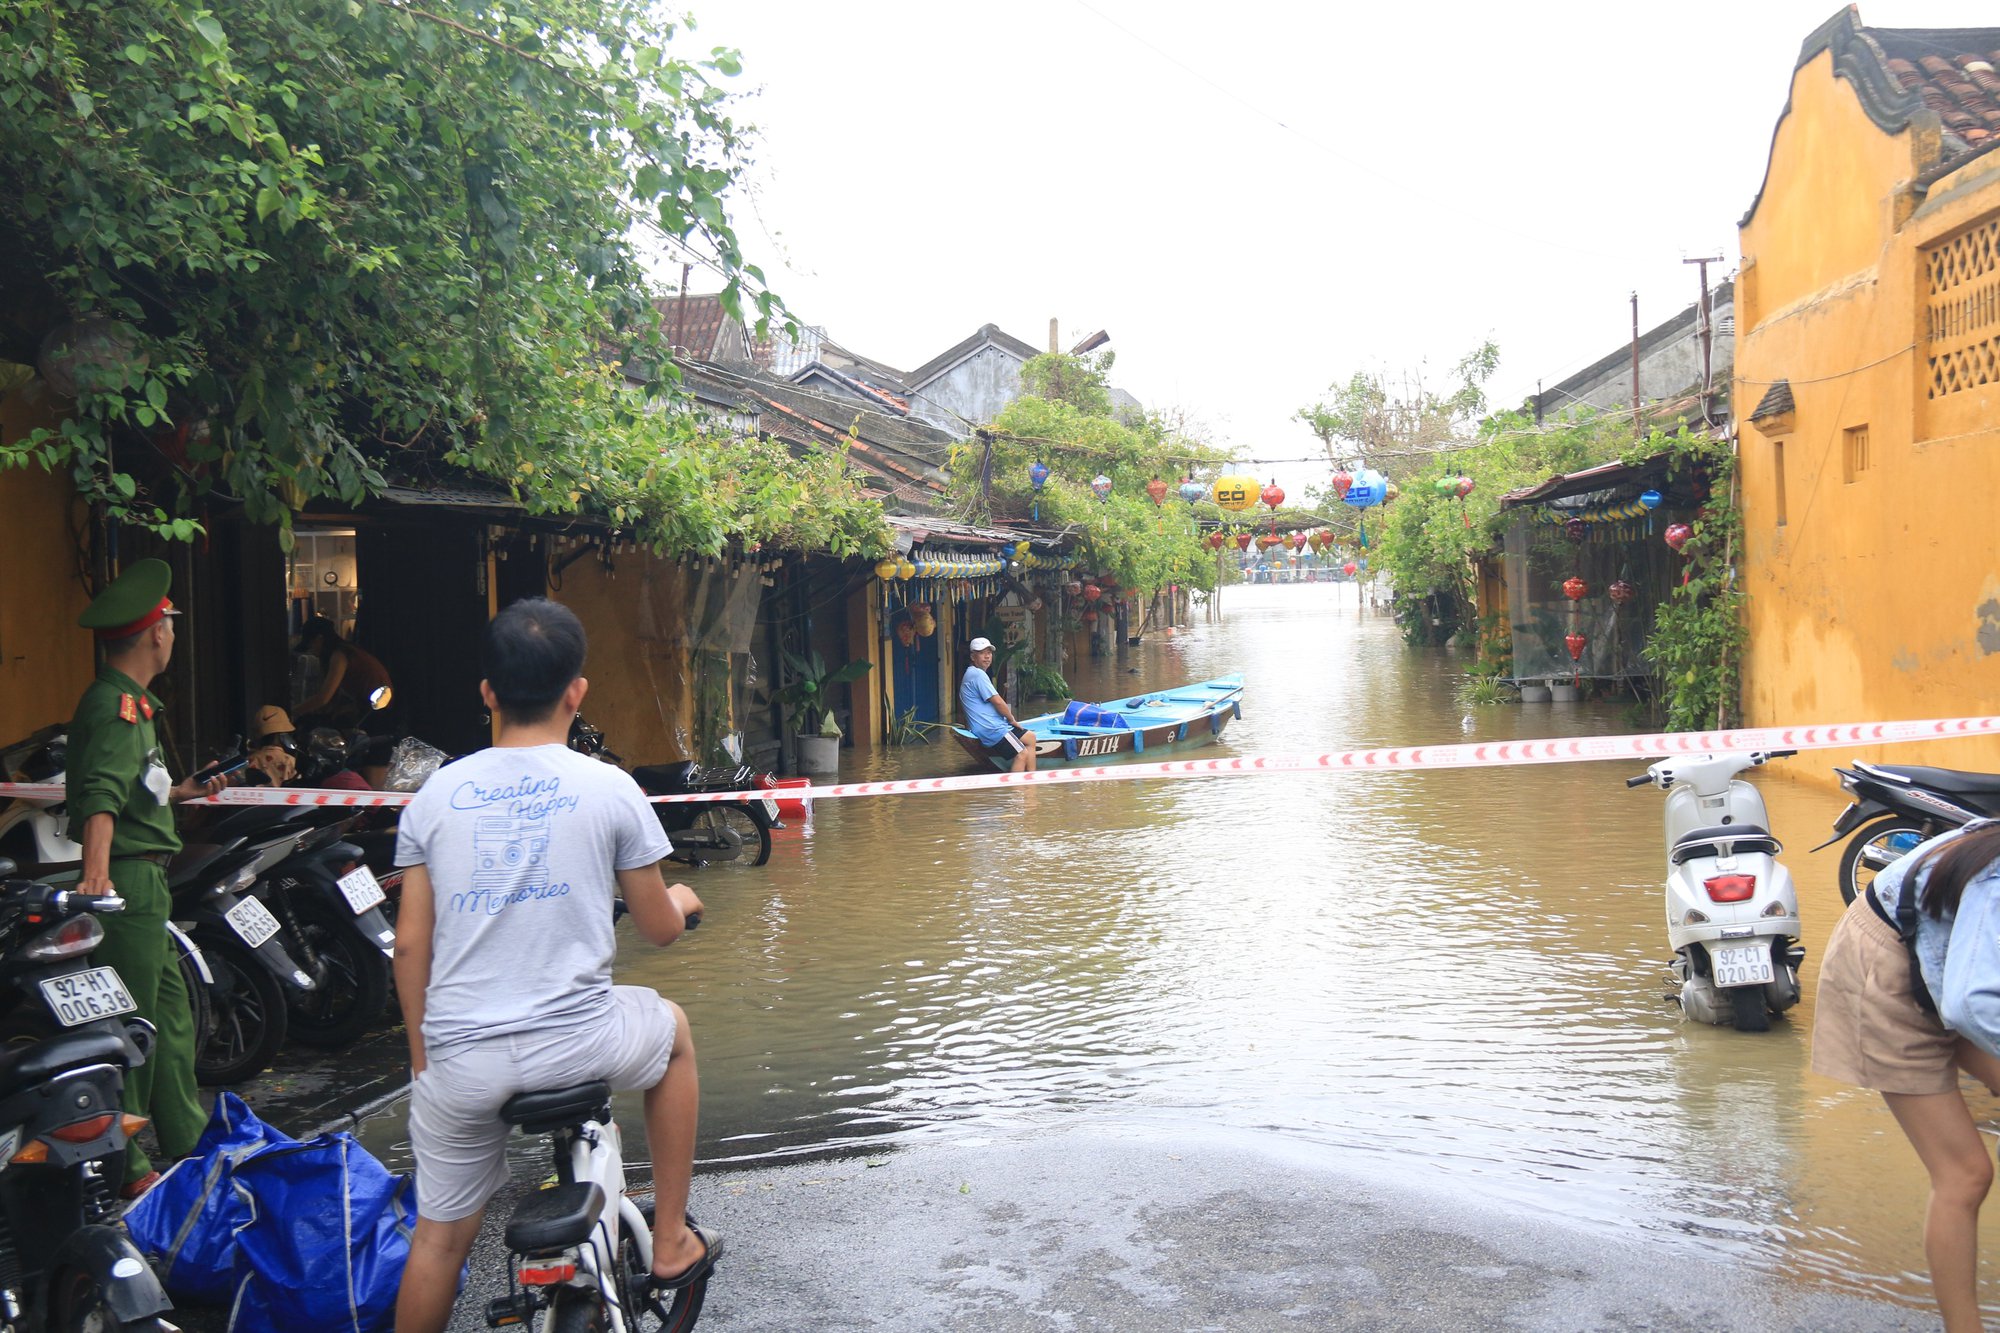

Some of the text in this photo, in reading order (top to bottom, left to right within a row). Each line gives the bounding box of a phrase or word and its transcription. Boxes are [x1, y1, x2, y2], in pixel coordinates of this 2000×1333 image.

[450, 775, 560, 810] Creating
[508, 793, 580, 820] Happy
[343, 870, 371, 894] 92-C1
[450, 882, 571, 915] Memories
[232, 900, 261, 926] 92-C1
[243, 913, 276, 944] 076.55
[1720, 946, 1761, 965] 92-C1
[54, 971, 111, 998] 92-H1
[1717, 964, 1770, 984] 020.50
[60, 990, 130, 1021] 006.38
